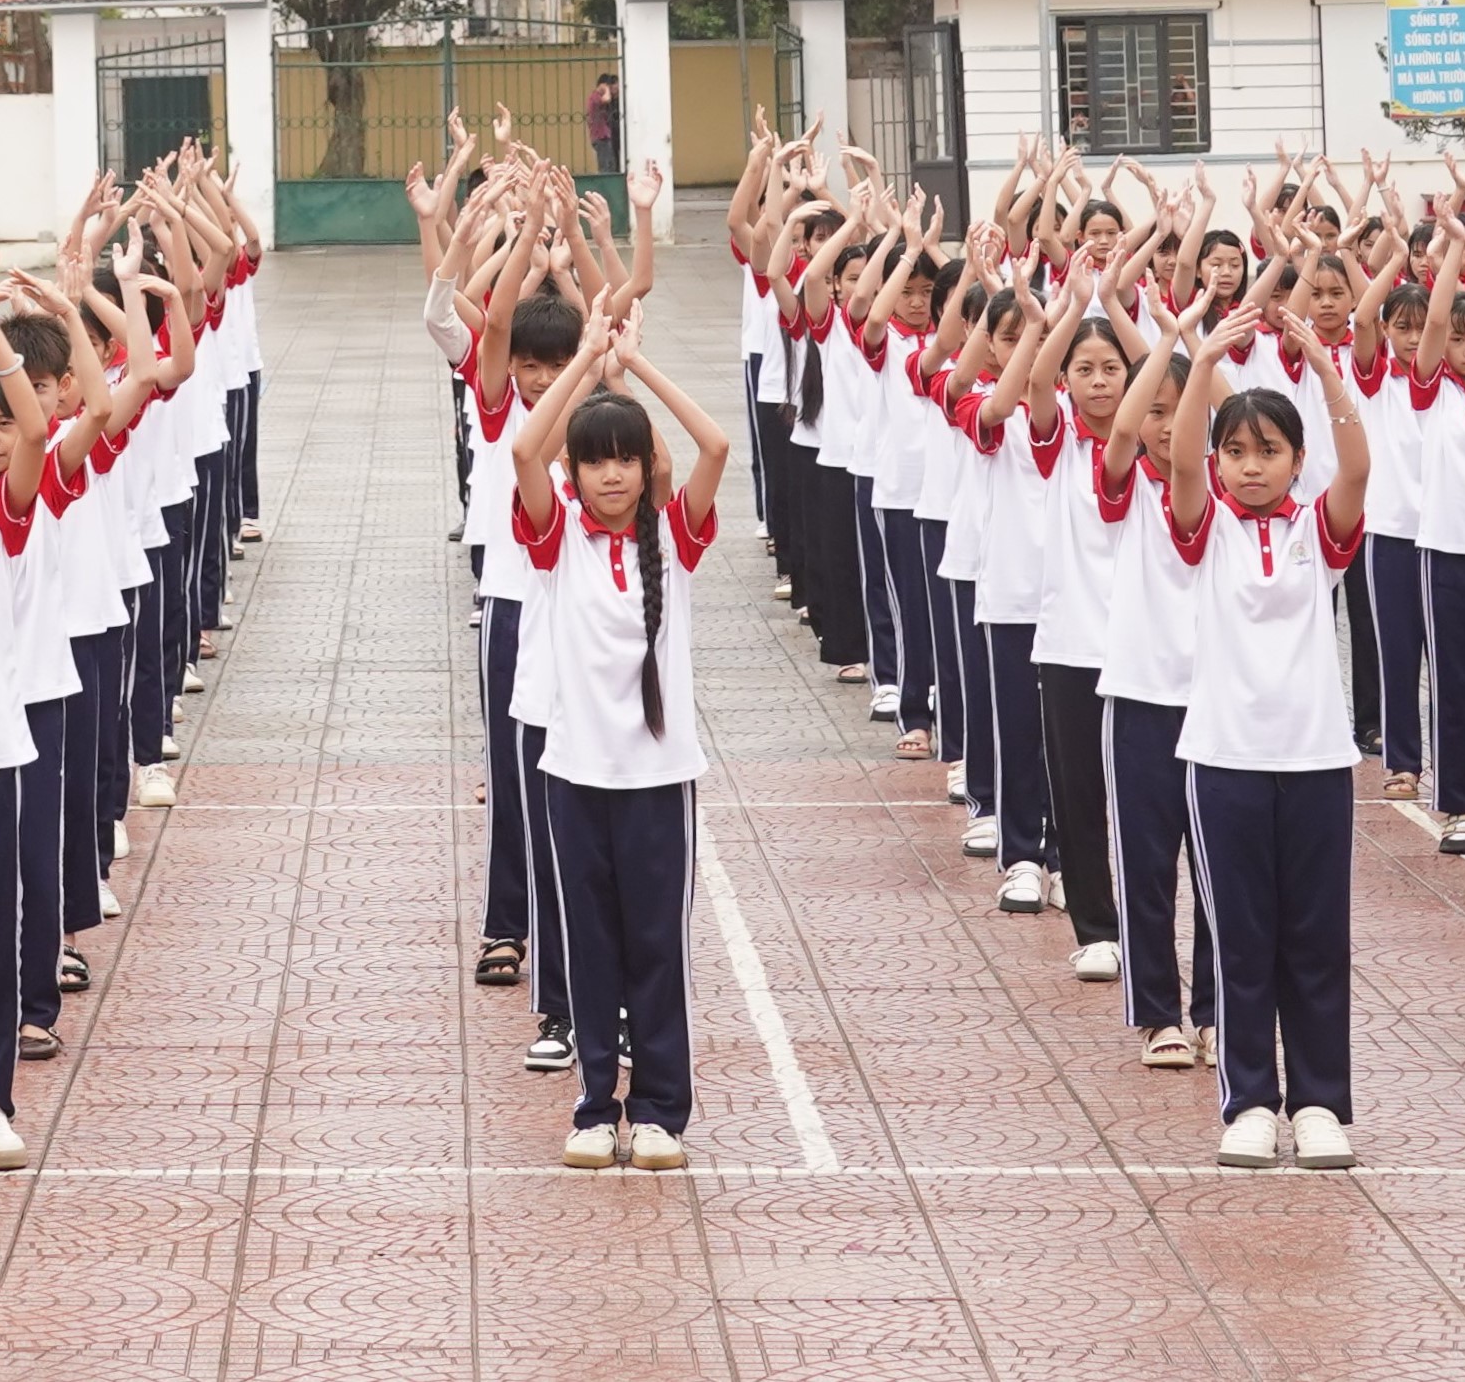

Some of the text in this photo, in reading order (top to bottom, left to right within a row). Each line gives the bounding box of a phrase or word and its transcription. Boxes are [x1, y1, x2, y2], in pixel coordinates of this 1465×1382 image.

[1409, 10, 1437, 28] SỐNG
[1404, 29, 1432, 47] SỐNG
[1433, 29, 1447, 46] CÓ
[1393, 50, 1407, 66] LÀ
[1408, 49, 1442, 66] NHỮNG
[1444, 48, 1462, 65] GIÁ
[1415, 68, 1437, 85] NHÀ
